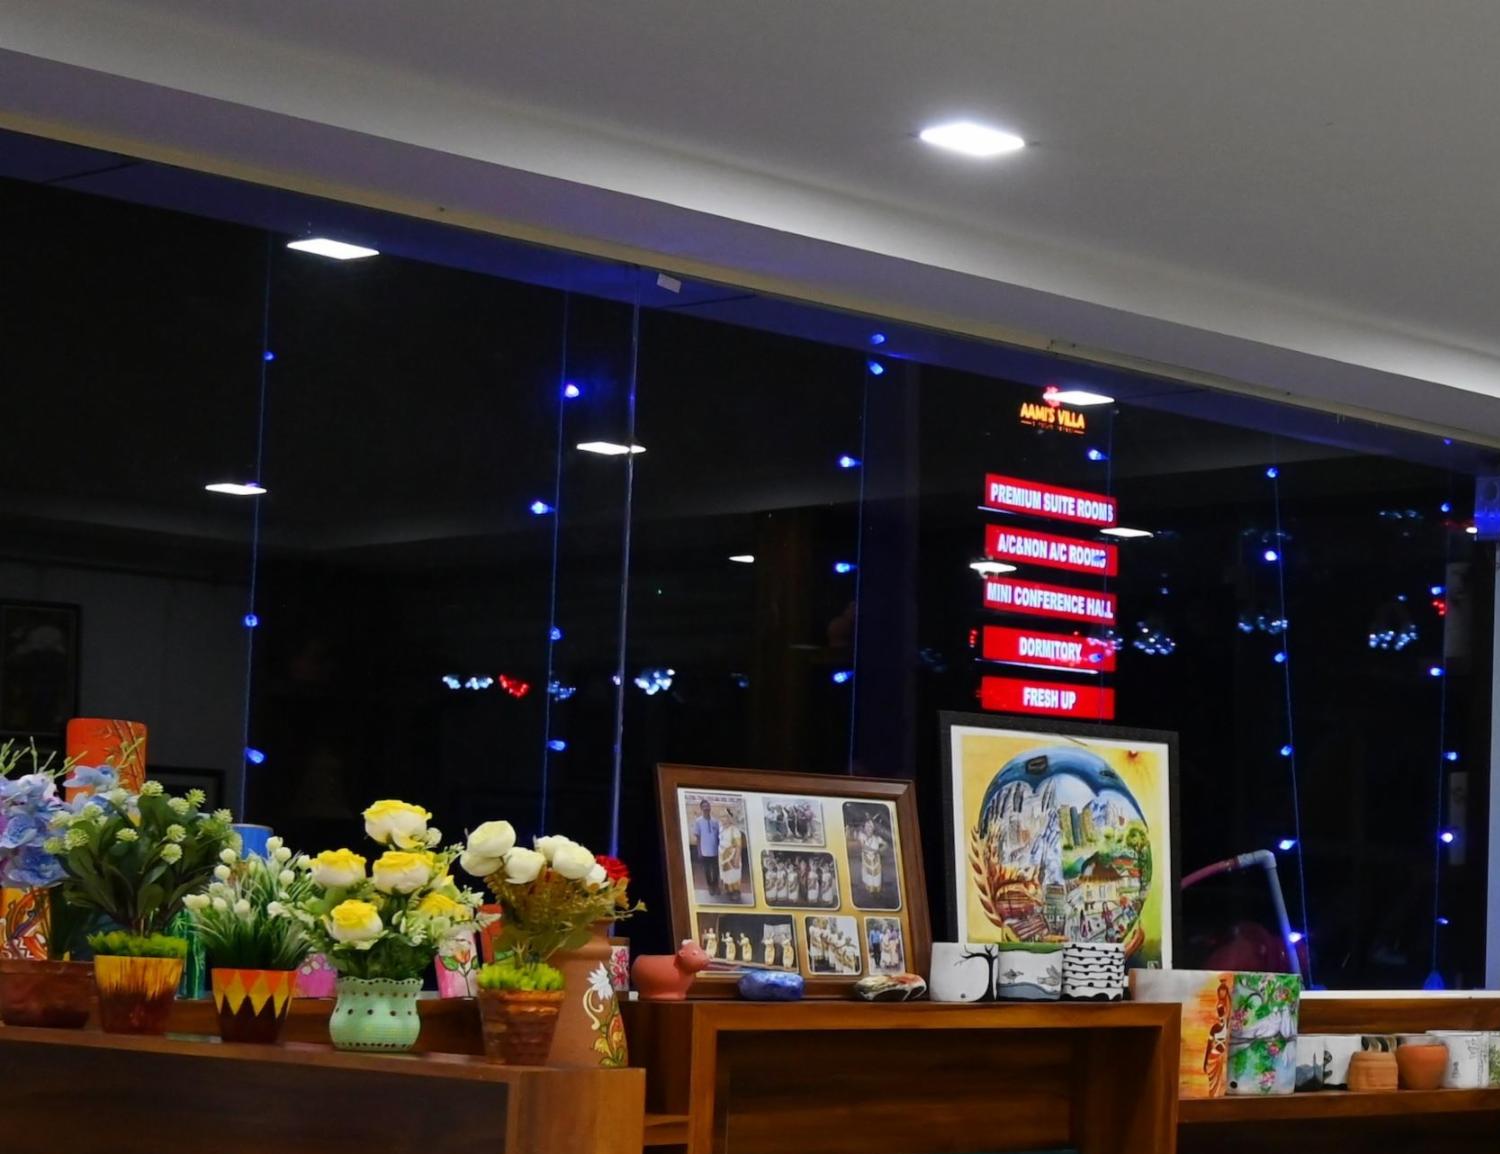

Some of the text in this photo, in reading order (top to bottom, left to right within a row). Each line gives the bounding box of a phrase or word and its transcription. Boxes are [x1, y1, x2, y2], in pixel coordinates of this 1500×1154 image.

[1057, 409, 1085, 429] VILLA
[990, 483, 1114, 522] PREMIUM SUITE ROOMS
[1049, 543, 1067, 562] A/C
[1068, 545, 1106, 569] ROOMS
[986, 582, 1114, 619] MINI CONFERENCE HALL
[1018, 637, 1083, 662] DORMITORY
[1023, 687, 1077, 710] FRESH UP
